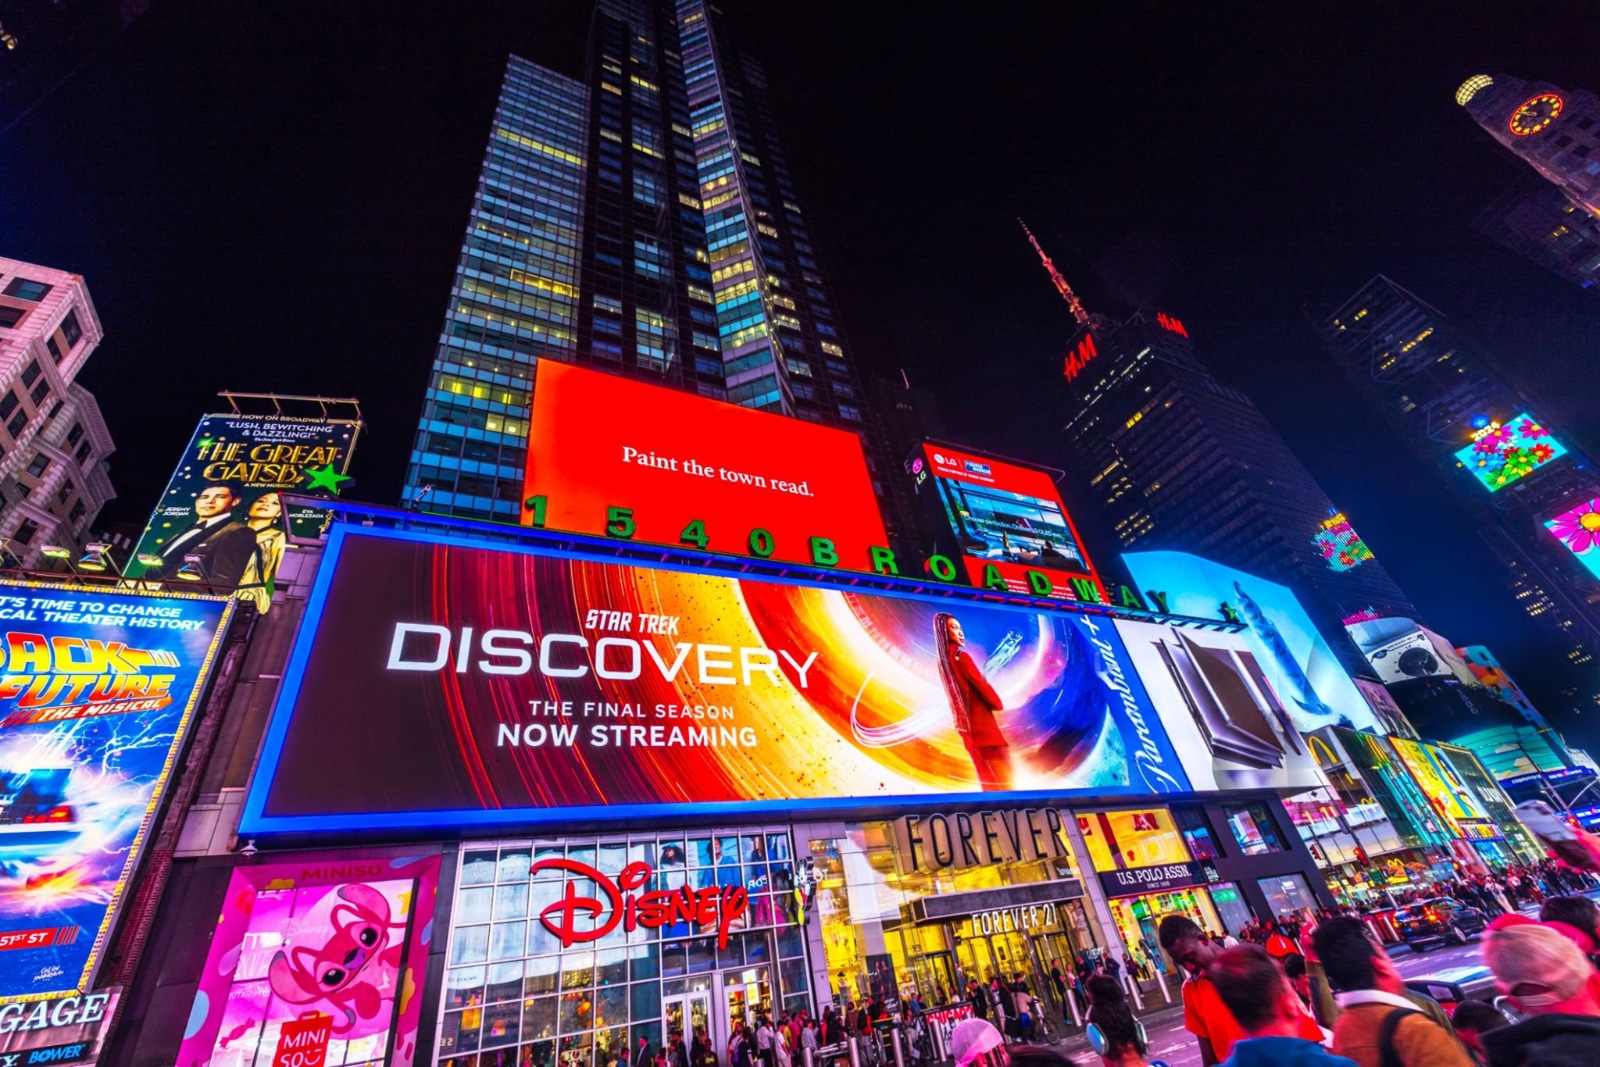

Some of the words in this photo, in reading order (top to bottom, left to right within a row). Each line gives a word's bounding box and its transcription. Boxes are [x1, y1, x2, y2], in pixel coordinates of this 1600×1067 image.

[1063, 333, 1098, 383] H&M
[263, 423, 333, 433] BEWITCHING
[1471, 421, 1500, 442] 2024
[197, 441, 247, 461] THE
[250, 443, 342, 465] GREAT
[622, 446, 678, 471] Paint
[683, 459, 714, 478] the
[719, 467, 766, 488] town
[770, 476, 814, 497] read.
[809, 536, 1170, 614] BROADWAY
[32, 598, 76, 611] TIME
[84, 602, 104, 613] TO
[107, 604, 182, 618] CHANGE
[44, 611, 125, 627] THEATER
[129, 615, 205, 631] HISTORY
[586, 609, 632, 632] STAR
[638, 613, 680, 636] TREK
[0, 631, 168, 674] ACK
[386, 622, 819, 689] DISCOVERY
[0, 674, 175, 708] FUTURE
[39, 706, 80, 721] THE
[84, 699, 162, 716] MUSICAL
[529, 700, 573, 717] THE
[584, 702, 646, 718] FINAL
[655, 704, 734, 719] SEASON
[497, 723, 578, 747] NOW
[590, 725, 758, 747] STREAMING
[903, 807, 1070, 872] FOREVER
[301, 865, 382, 880] MINISO
[1116, 871, 1137, 885] U.S.
[1135, 868, 1163, 883] POLO
[1163, 864, 1192, 879] ASSN.
[972, 906, 1040, 937] FOREVER
[1043, 903, 1057, 926] 21
[27, 932, 49, 945] ST
[0, 994, 109, 1033] GAGE
[283, 1029, 326, 1049] MINI
[28, 1044, 85, 1064] BOWER
